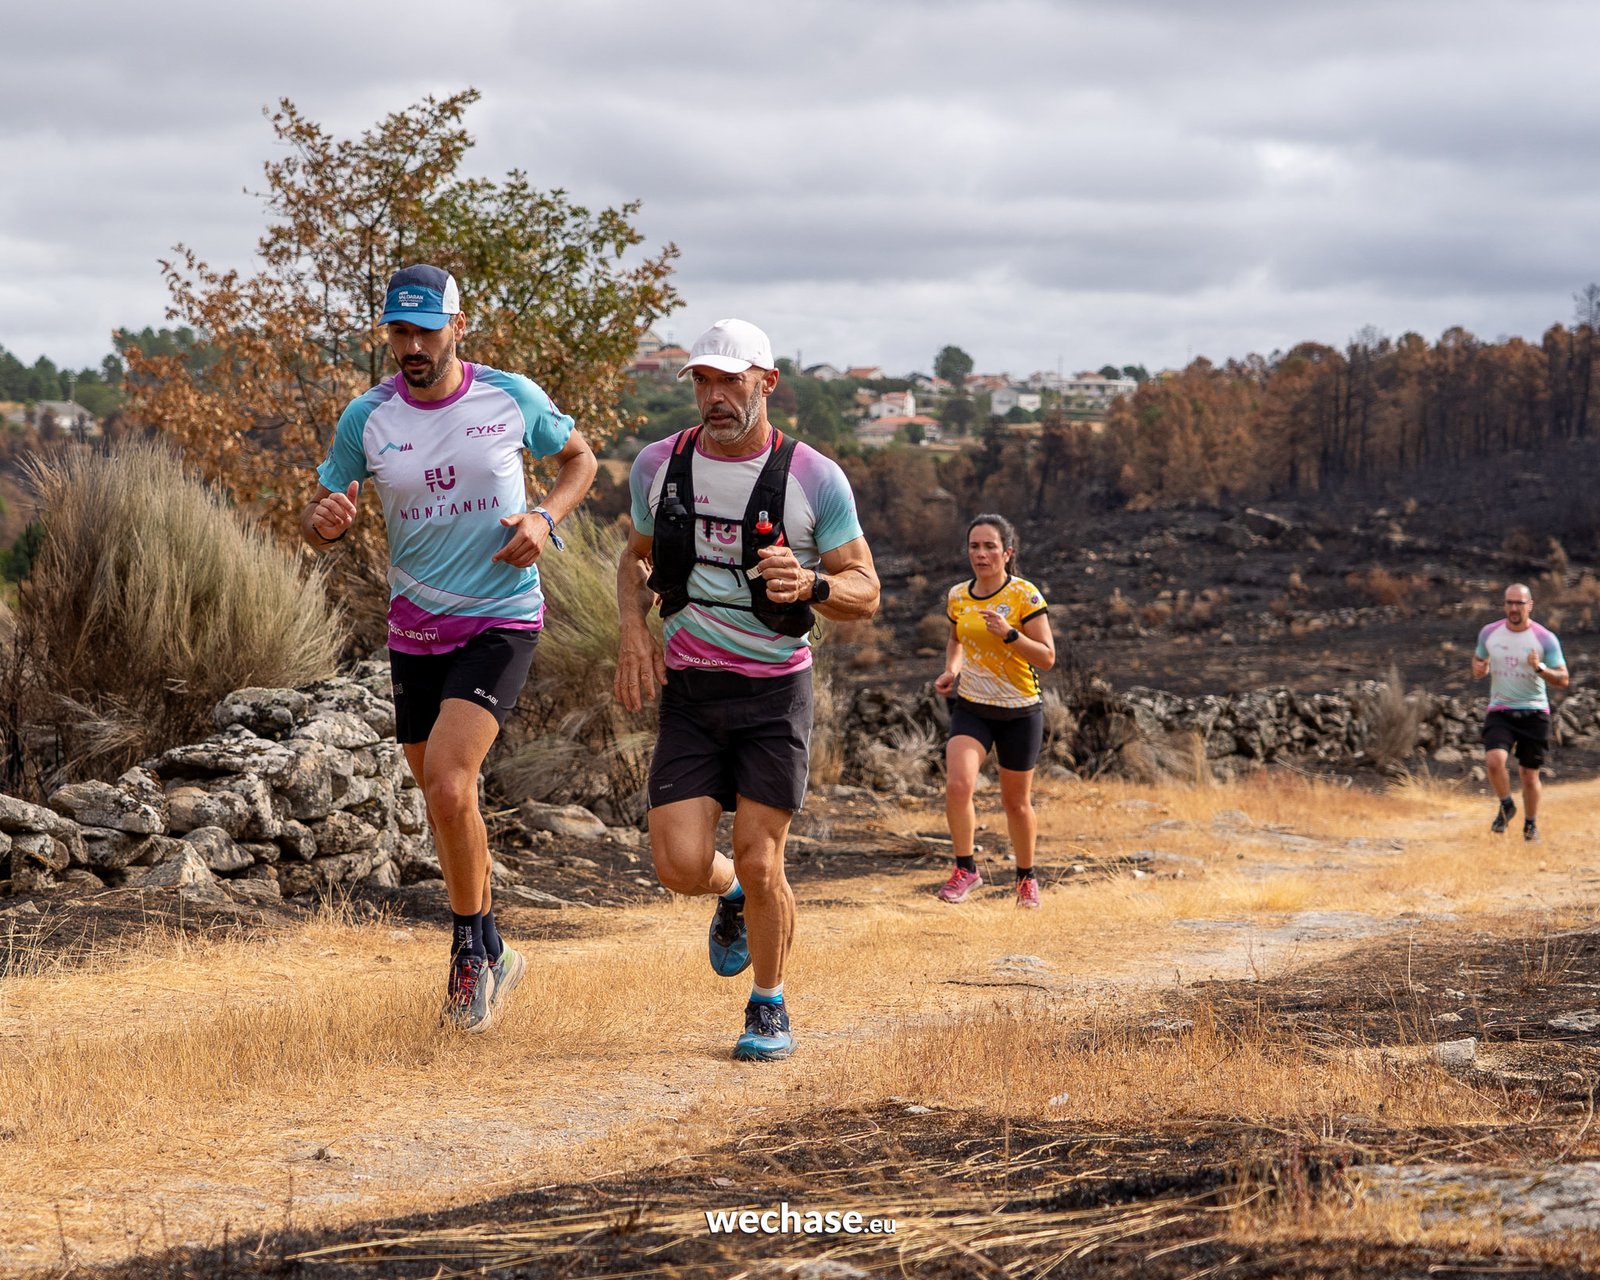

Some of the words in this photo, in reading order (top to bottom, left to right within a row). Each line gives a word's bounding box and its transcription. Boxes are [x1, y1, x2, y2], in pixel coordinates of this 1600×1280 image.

[466, 423, 507, 436] FYKE
[400, 496, 500, 520] MONTANHA
[424, 631, 437, 641] tv
